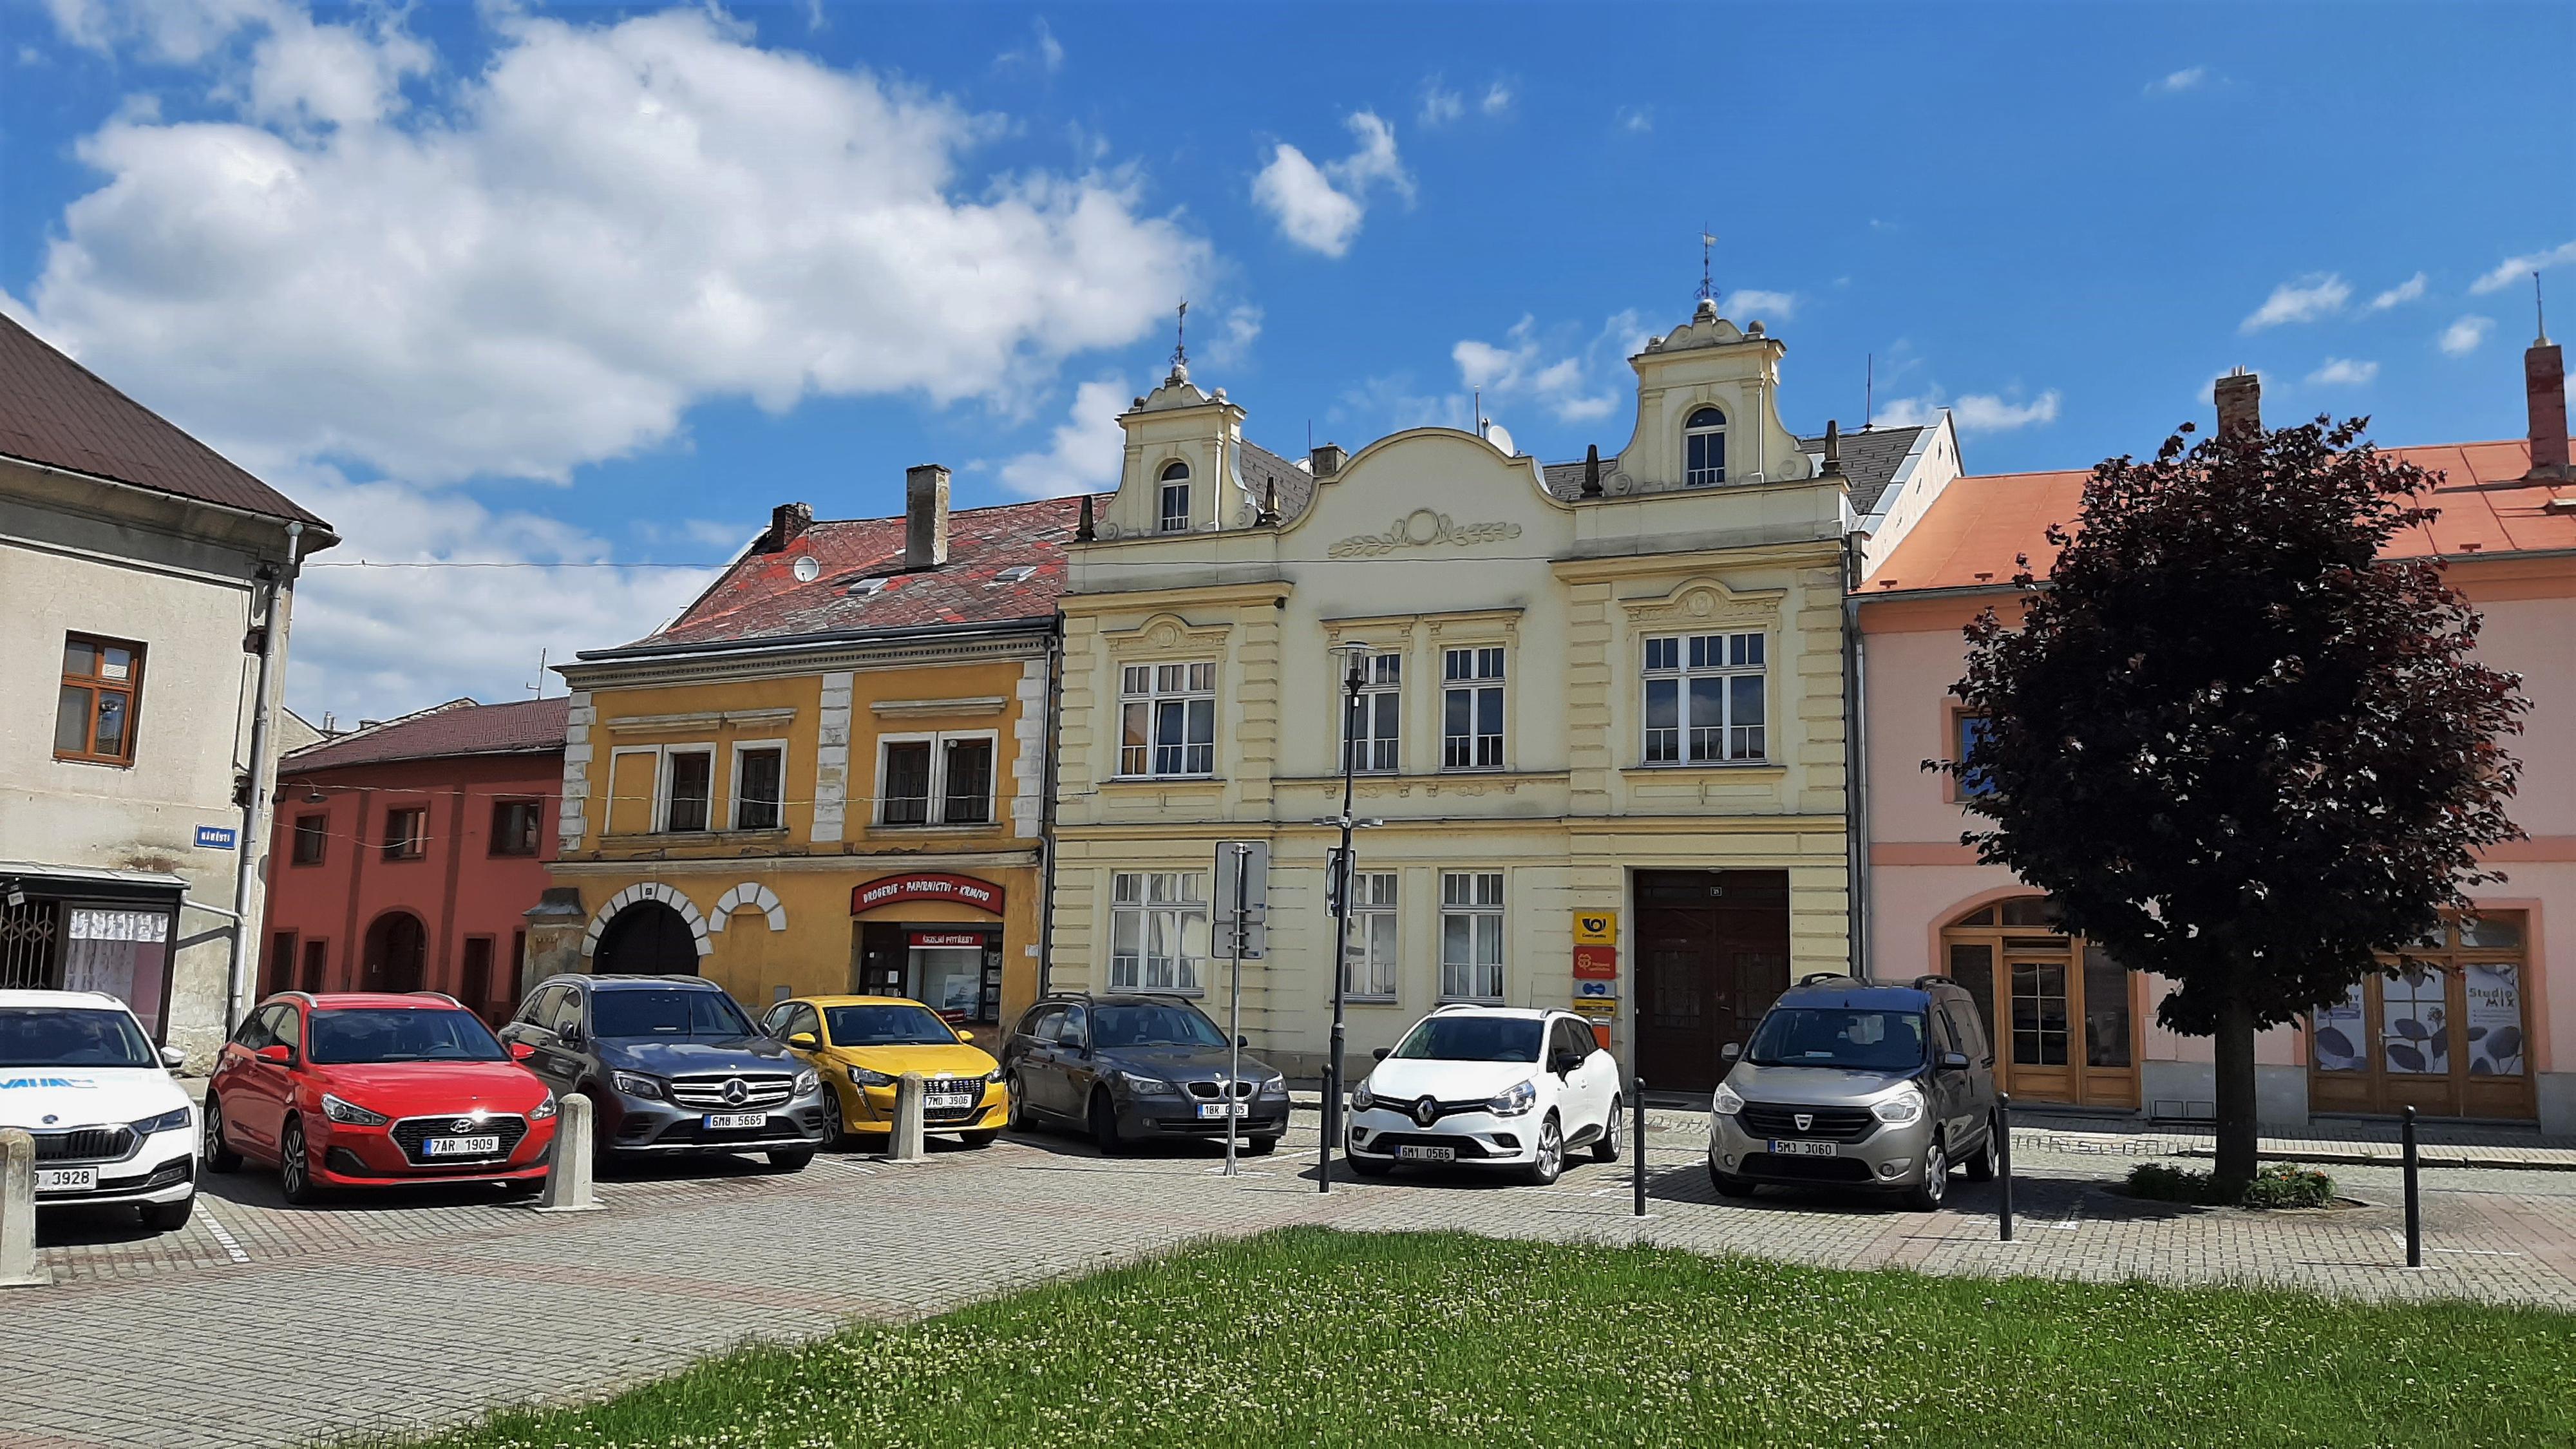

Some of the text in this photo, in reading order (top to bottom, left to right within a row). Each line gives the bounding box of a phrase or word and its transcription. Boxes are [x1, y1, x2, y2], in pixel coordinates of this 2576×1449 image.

[863, 884, 898, 903] DROGERIE
[959, 886, 990, 901] KRMIVO
[2469, 987, 2512, 998] Studio
[2486, 998, 2514, 1007] MIX
[738, 1115, 762, 1126] 5665
[433, 1139, 493, 1152] 7AR 1909
[1777, 1141, 1832, 1155] 5M3 3060
[1426, 1148, 1450, 1159] 0566
[52, 1171, 90, 1185] 3928
